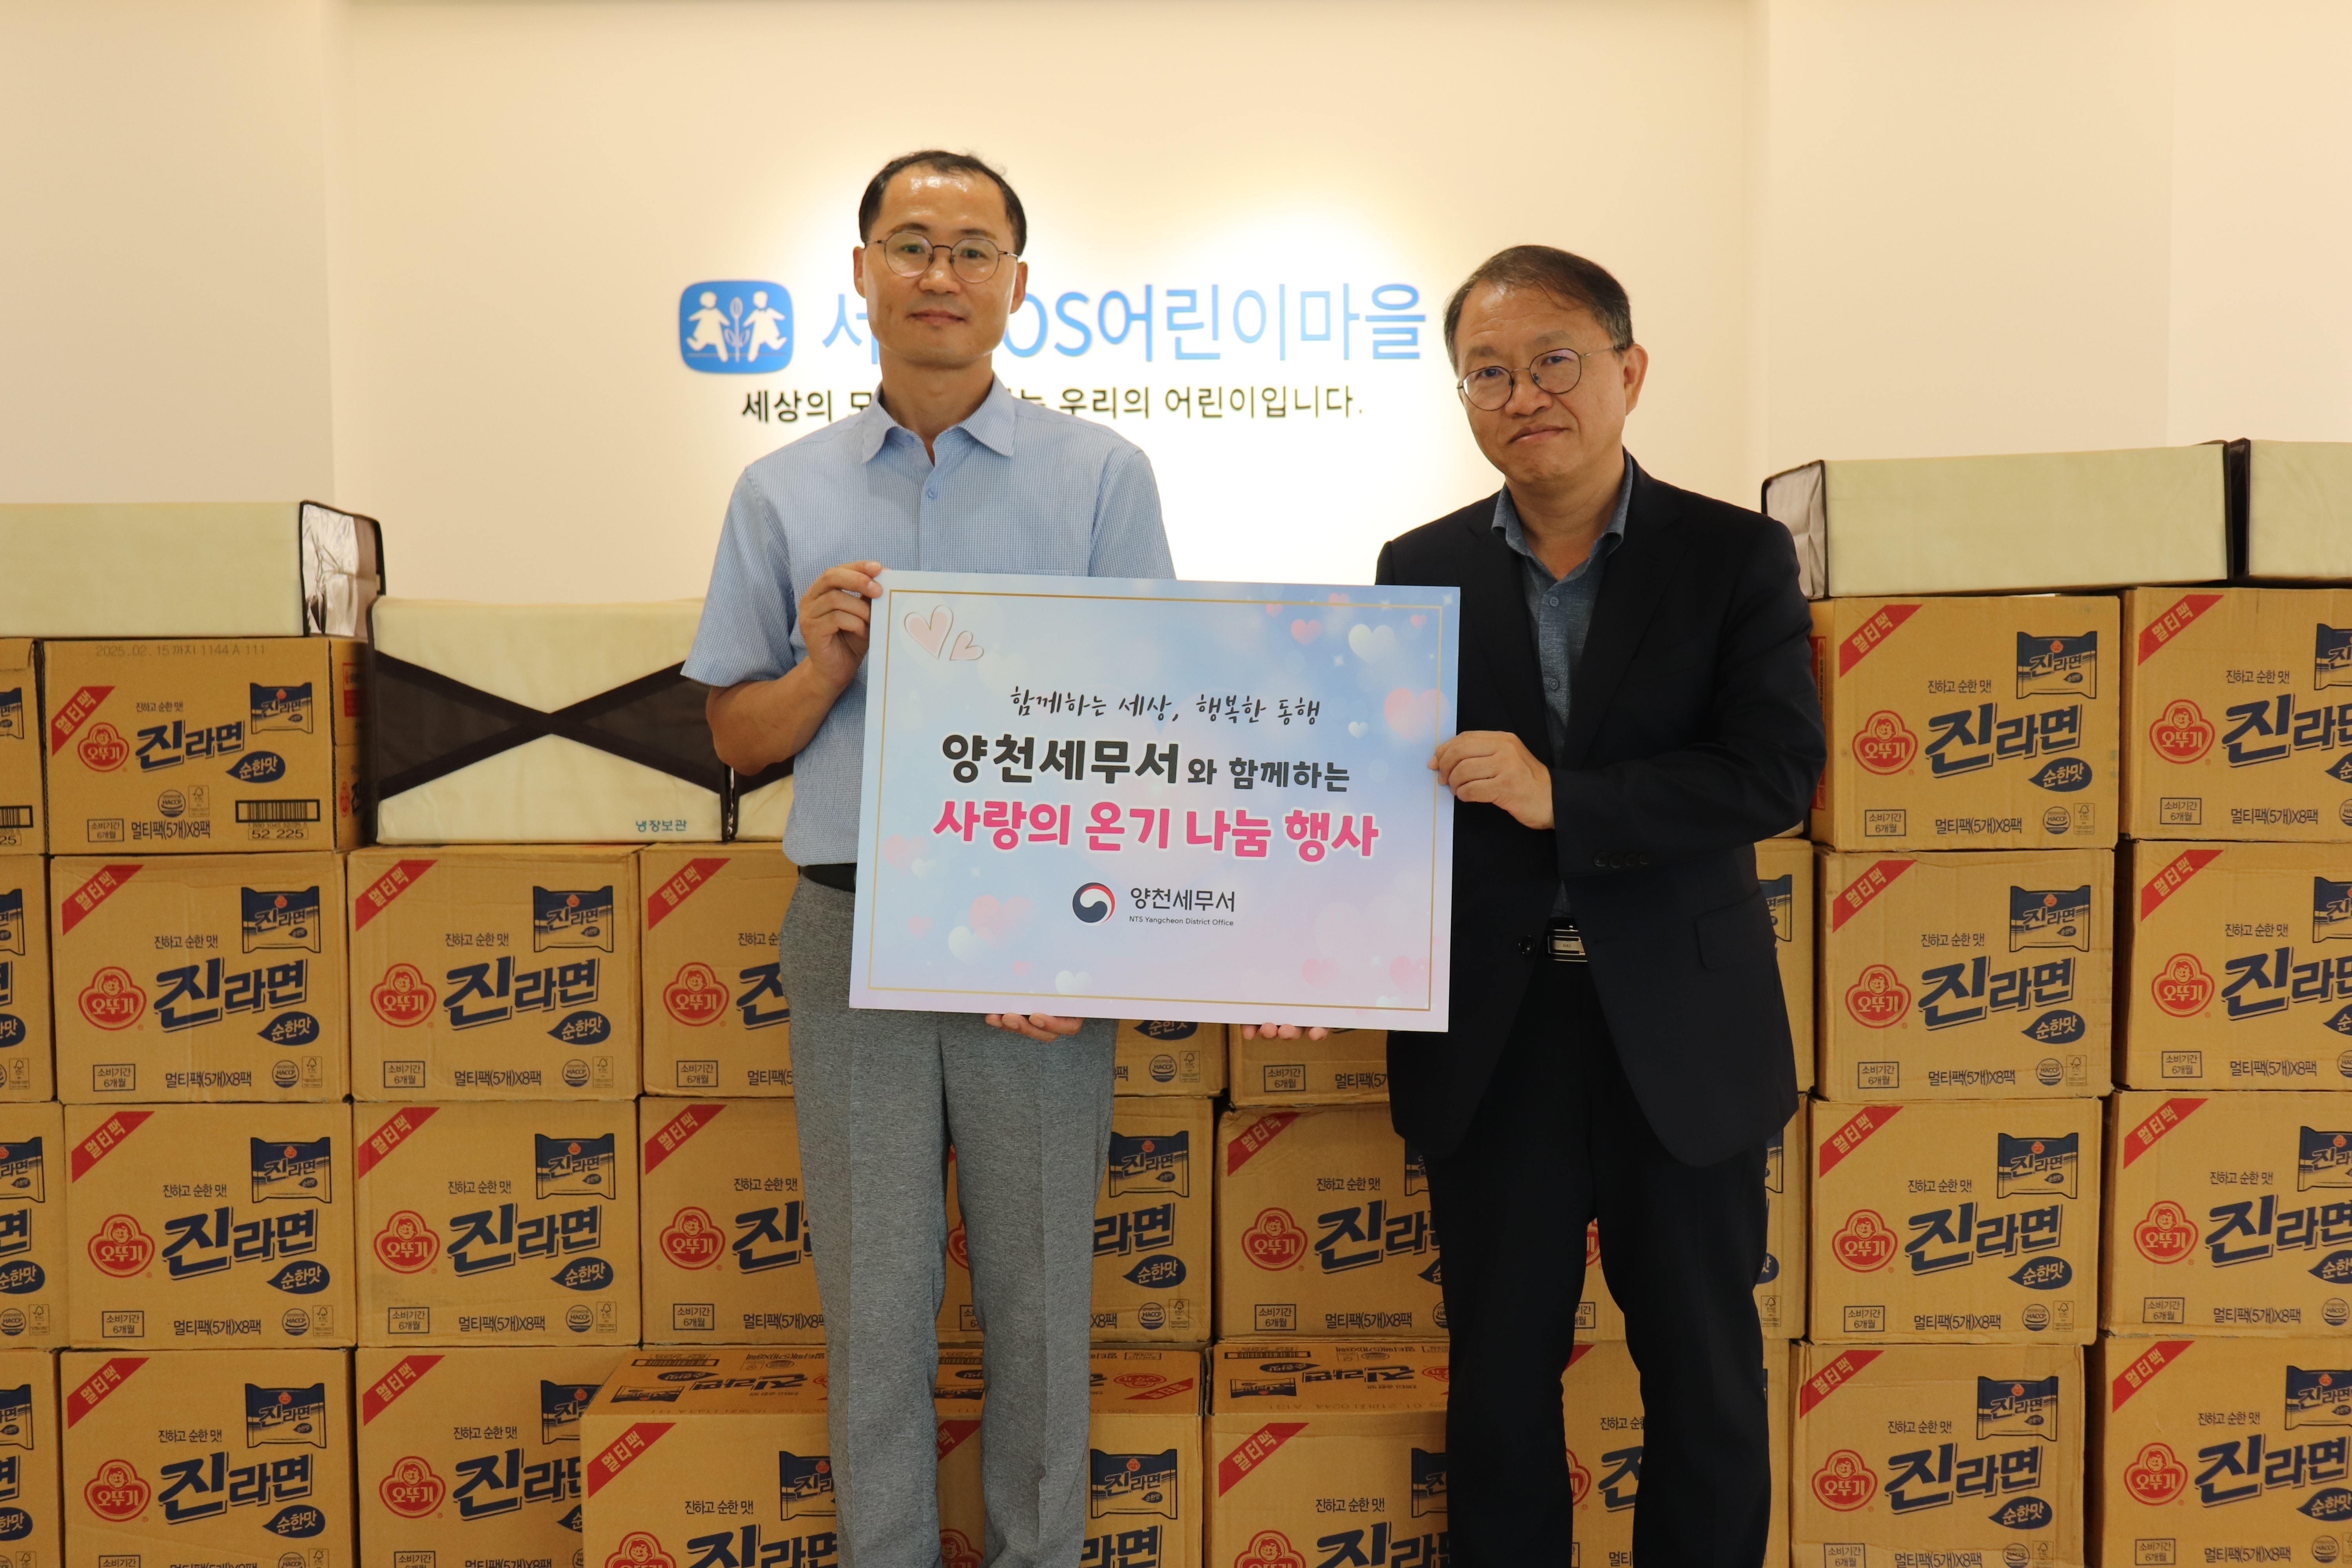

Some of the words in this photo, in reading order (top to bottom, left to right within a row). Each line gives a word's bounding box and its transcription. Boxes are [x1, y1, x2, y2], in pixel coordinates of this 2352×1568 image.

[742, 390, 832, 422] 세상의
[1059, 387, 1149, 419] 우리의
[1165, 385, 1362, 419] 어린이입니다.
[1852, 613, 1893, 653] 멀티팩
[2152, 603, 2193, 642] 멀티팩
[2030, 653, 2082, 676] 진라면
[1928, 680, 1956, 693] 진하고
[1958, 680, 1977, 693] 순한
[55, 690, 97, 735] 멀티팩
[136, 702, 156, 713] 진하고
[158, 702, 173, 712] 순한
[261, 699, 302, 719] 진라면
[1010, 686, 1107, 717] 함께하는
[1119, 693, 1178, 721] 세상,
[1196, 694, 1267, 724] 행복한
[1278, 697, 1320, 725] 동행
[136, 720, 245, 773] 진라면
[1865, 742, 1906, 759] 오뚜기
[1925, 702, 2081, 778] 진라면
[2161, 731, 2203, 748] 오뚜기
[87, 747, 121, 761] 오뚜기
[239, 757, 278, 779] 순한맛
[1229, 757, 1350, 792] 함께하는
[2043, 764, 2083, 788] 순한맛
[636, 820, 686, 832] 냉장보관
[1869, 813, 1901, 822] 소비기간
[1875, 824, 1896, 833] 6개월
[97, 831, 116, 839] 6개월
[252, 829, 270, 838] 52
[276, 829, 304, 838] 225
[933, 800, 1071, 851] 사랑의
[1085, 802, 1170, 851] 온기
[1187, 810, 1272, 857] 나눔
[1285, 809, 1379, 862] 행사
[368, 867, 408, 907] 멀티팩
[660, 866, 701, 906] 멀티팩
[1844, 868, 1886, 908] 멀티팩
[2154, 858, 2193, 896] 멀티팩
[75, 871, 116, 910] 멀티팩
[1131, 888, 1235, 912] 양천세무서
[547, 907, 599, 930] 진라면
[445, 933, 473, 947] 진하고
[476, 933, 494, 946] 순한
[153, 957, 308, 1032] 진라면
[383, 995, 424, 1011] 오뚜기
[443, 956, 599, 1030] 진라면
[676, 994, 717, 1011] 오뚜기
[1858, 996, 1899, 1012] 오뚜기
[1919, 956, 2074, 1030] 진라면
[2163, 984, 2203, 1001] 오뚜기
[93, 998, 133, 1014] 오뚜기
[271, 1017, 311, 1041] 순한맛
[562, 1016, 602, 1040] 순한맛
[2036, 1016, 2076, 1039] 순한맛
[388, 1065, 420, 1074] 소비기간
[394, 1075, 415, 1084] 6개월
[681, 1065, 713, 1074] 소비기간
[687, 1074, 708, 1084] 6개월
[1268, 1069, 1300, 1078] 소비기간
[1275, 1079, 1295, 1088] 6개월
[370, 1115, 411, 1154] 멀티팩
[657, 1111, 698, 1151] 멀티팩
[1241, 1116, 1281, 1152] 멀티팩
[1831, 1114, 1873, 1154] 멀티팩
[2137, 1106, 2178, 1145] 멀티팩
[84, 1119, 125, 1158] 멀티팩
[1122, 1153, 1174, 1175] 진라면
[163, 1184, 191, 1198] 진하고
[194, 1184, 212, 1197] 순한
[734, 1178, 762, 1191] 진하고
[764, 1178, 783, 1191] 순한
[1908, 1180, 1936, 1193] 진하고
[1939, 1180, 1957, 1193] 순한
[162, 1207, 318, 1280] 진라면
[387, 1241, 427, 1258] 오뚜기
[447, 1203, 602, 1276] 진라면
[672, 1238, 713, 1254] 오뚜기
[1254, 1239, 1295, 1255] 오뚜기
[1844, 1240, 1885, 1257] 오뚜기
[1905, 1202, 2062, 1275] 진라면
[2145, 1232, 2186, 1248] 오뚜기
[101, 1245, 142, 1262] 오뚜기
[281, 1266, 321, 1290] 순한맛
[565, 1263, 605, 1286] 순한맛
[1137, 1260, 1178, 1283] 순한맛
[2023, 1262, 2063, 1285] 순한맛
[392, 1311, 425, 1320] 소비기간
[399, 1321, 419, 1330] 6개월
[1812, 1357, 1853, 1394] 멀티팩
[2125, 1349, 2165, 1388] 멀티팩
[80, 1365, 121, 1404] 멀티팩
[375, 1363, 416, 1402] 멀티팩
[1600, 1417, 1627, 1430] 진하고
[600, 1430, 644, 1472] 멀티팩
[1232, 1428, 1276, 1471] 멀티팩
[1885, 1443, 2042, 1515] 진라면
[2136, 1473, 2176, 1490] 오뚜기
[2195, 1434, 2350, 1507] 진라면
[158, 1452, 314, 1524] 진라면
[392, 1487, 433, 1503] 오뚜기
[1105, 1472, 1161, 1497] 진라면
[1824, 1480, 1865, 1496] 오뚜기
[97, 1490, 138, 1506] 오뚜기
[685, 1501, 715, 1515] 진하고
[718, 1501, 738, 1514] 순한
[277, 1510, 317, 1534] 순한맛
[2003, 1502, 2043, 1525] 순한맛
